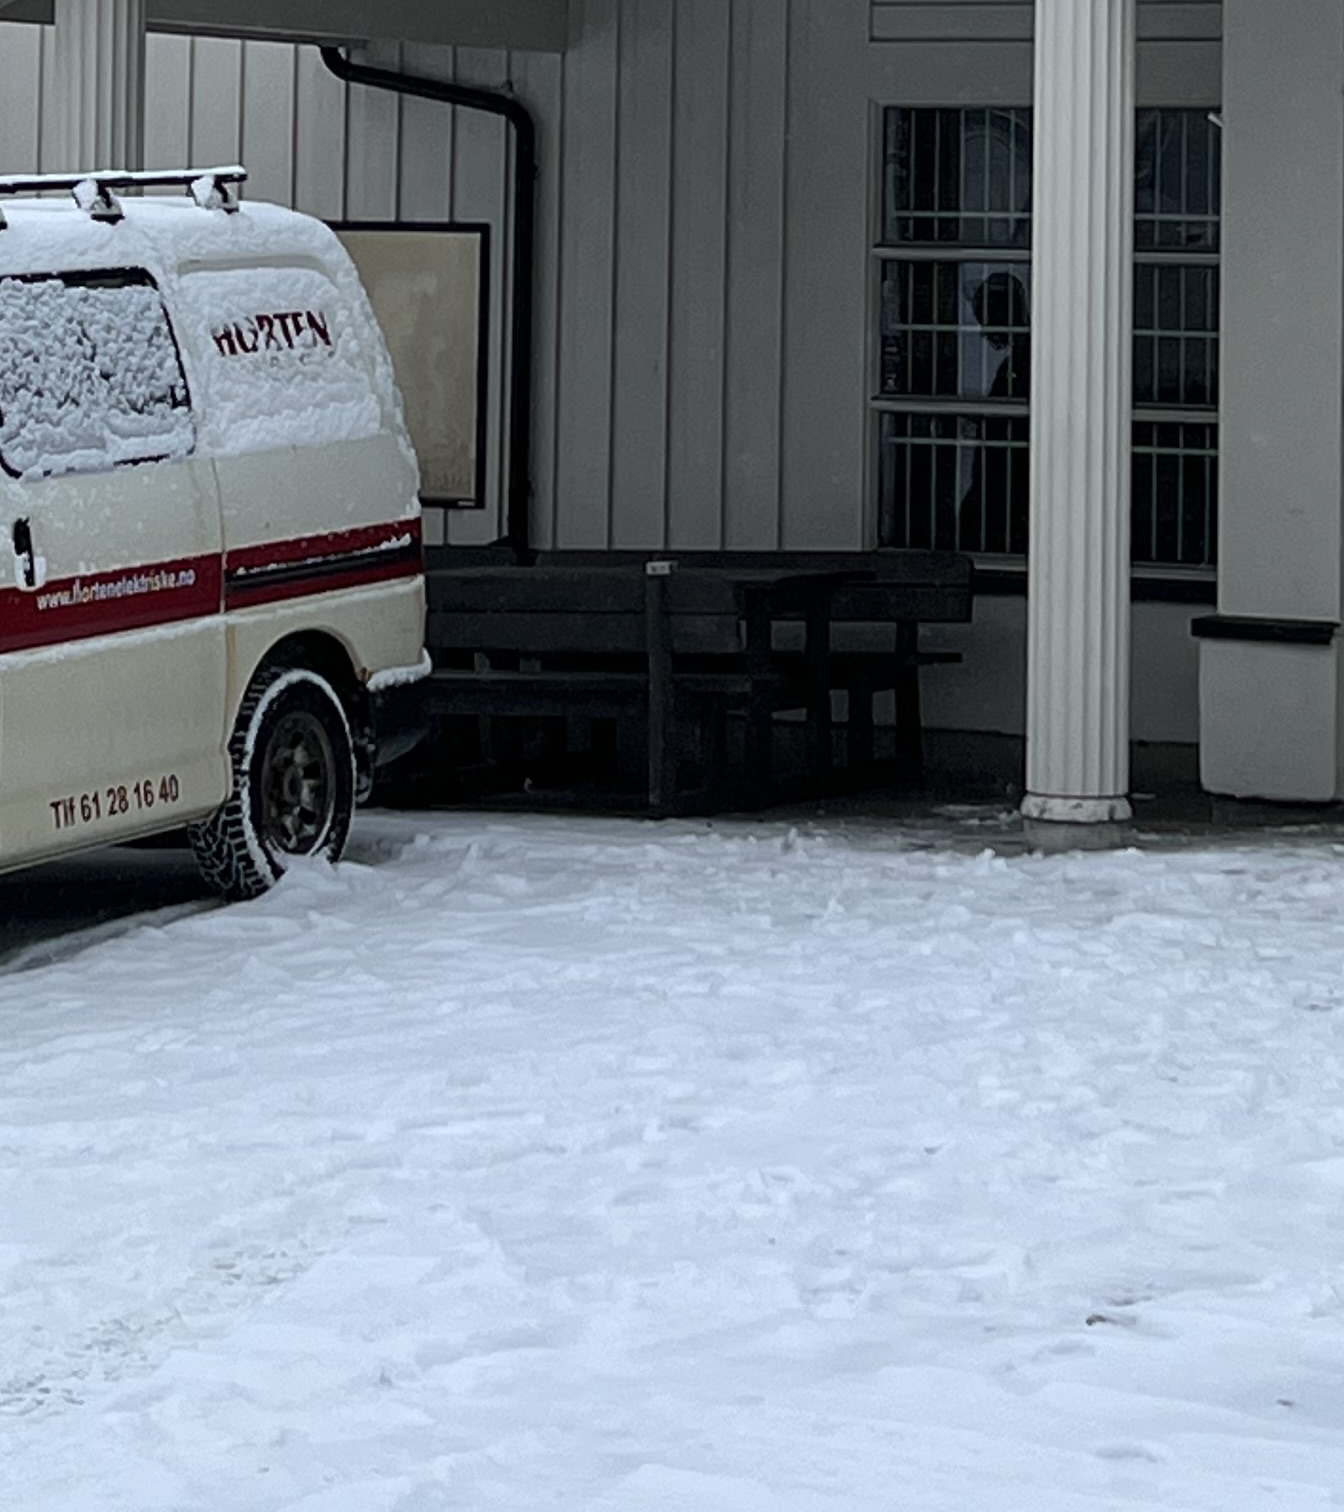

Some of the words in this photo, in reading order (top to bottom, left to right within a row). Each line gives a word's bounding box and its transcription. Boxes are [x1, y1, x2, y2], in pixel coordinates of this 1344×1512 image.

[36, 569, 196, 611] www.hortenelektriske.no
[50, 796, 76, 829] Tlf
[80, 790, 101, 823] 61
[106, 785, 129, 816] 28
[133, 779, 154, 808] 16
[159, 774, 179, 803] 40
